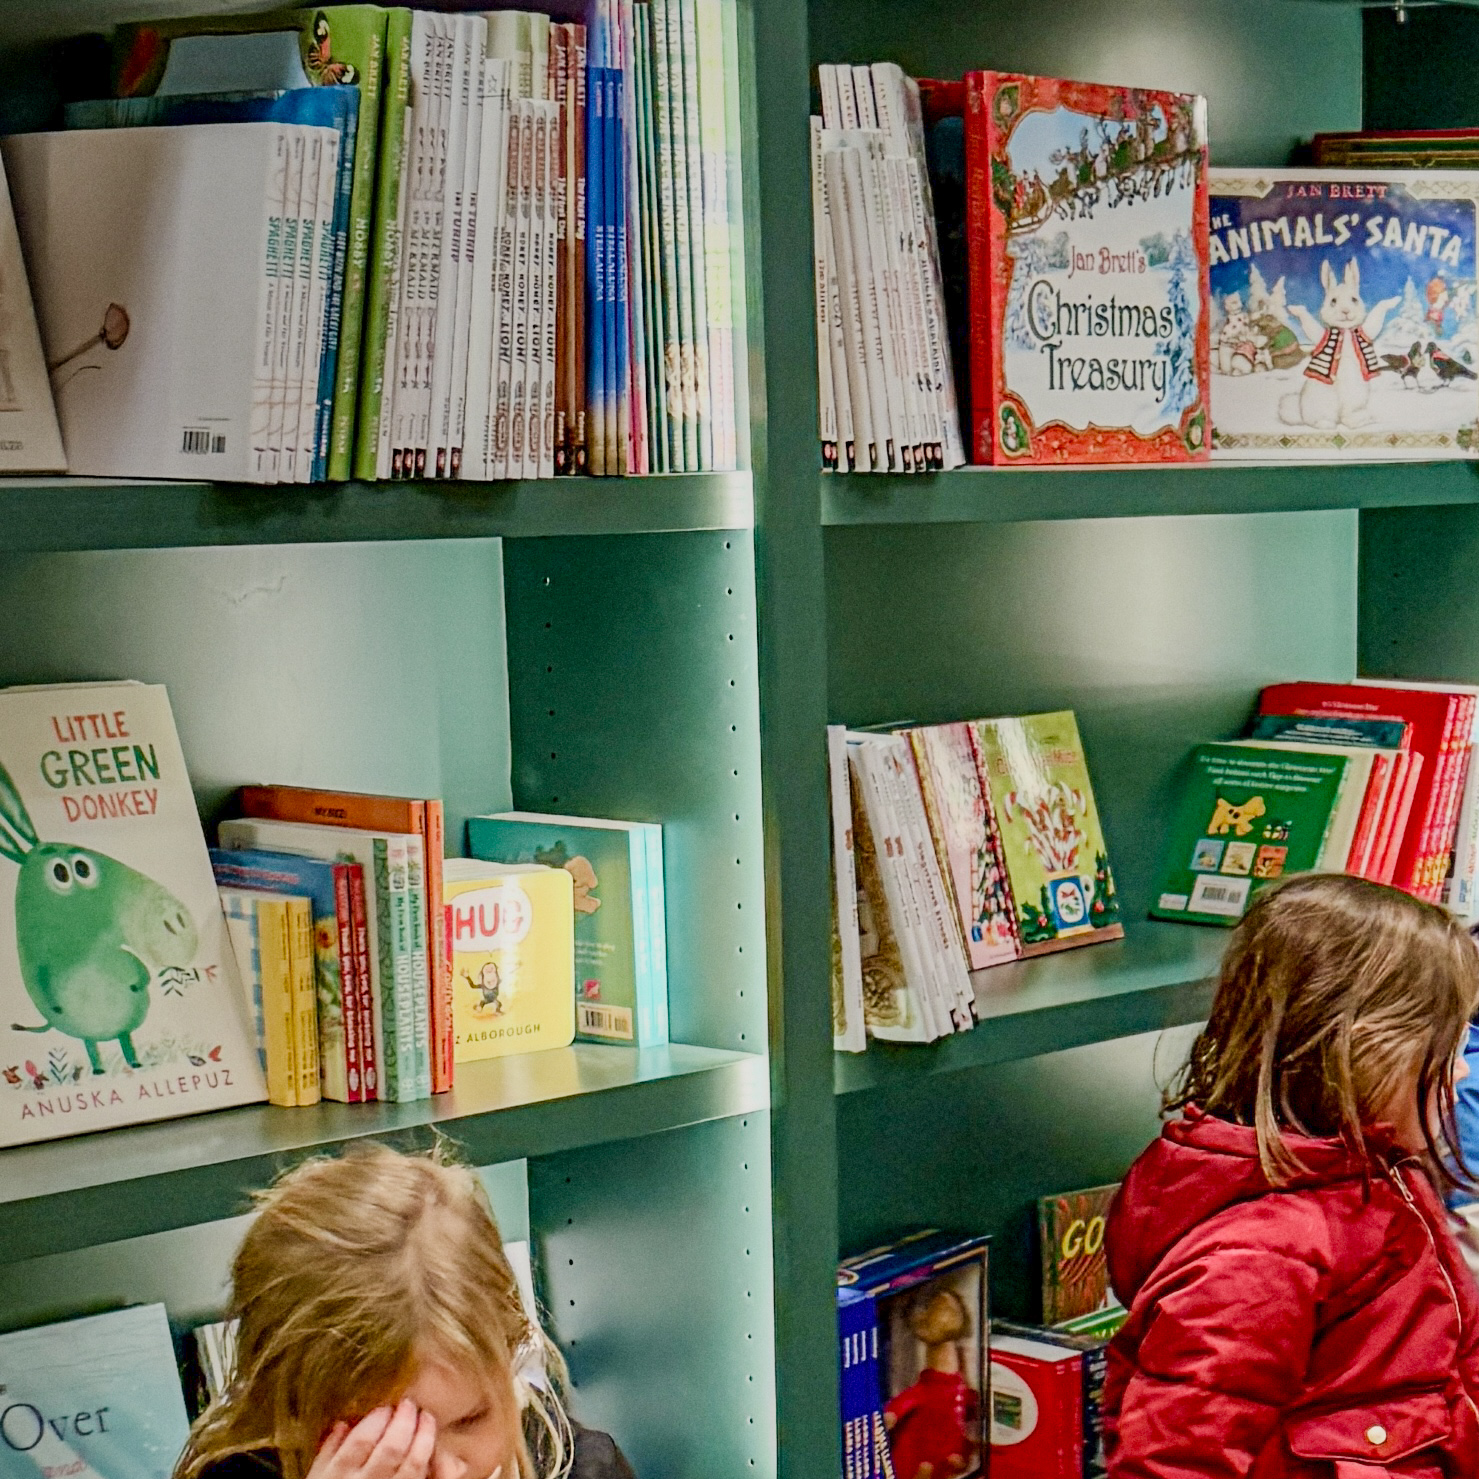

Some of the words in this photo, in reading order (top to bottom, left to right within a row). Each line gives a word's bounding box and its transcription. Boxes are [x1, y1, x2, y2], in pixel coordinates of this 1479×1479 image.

[1285, 184, 1322, 199] JAN
[1328, 184, 1388, 199] BRETT
[265, 216, 281, 278] SPAGHETTI
[280, 217, 298, 279] SPAGHETTI
[298, 218, 315, 280] SPAGHETTI
[1067, 245, 1096, 279] Jan
[1098, 246, 1148, 275] Brett's
[1209, 212, 1360, 267] ANIMALS'
[1364, 215, 1462, 267] SANTA
[1027, 279, 1174, 342] Christmas
[1040, 340, 1168, 404] Treasury
[51, 710, 130, 743] LITTLE
[40, 743, 160, 789] GREEN
[62, 788, 158, 823] DONKEY
[396, 955, 413, 1053] HOUSEPLANTS
[411, 951, 427, 1048] HOUSEPLANTS
[466, 1023, 541, 1043] ALBOROUGH
[22, 1090, 124, 1120] ANUSKA
[138, 1069, 234, 1100] ALLEPUZ
[0, 1403, 110, 1451] Over
